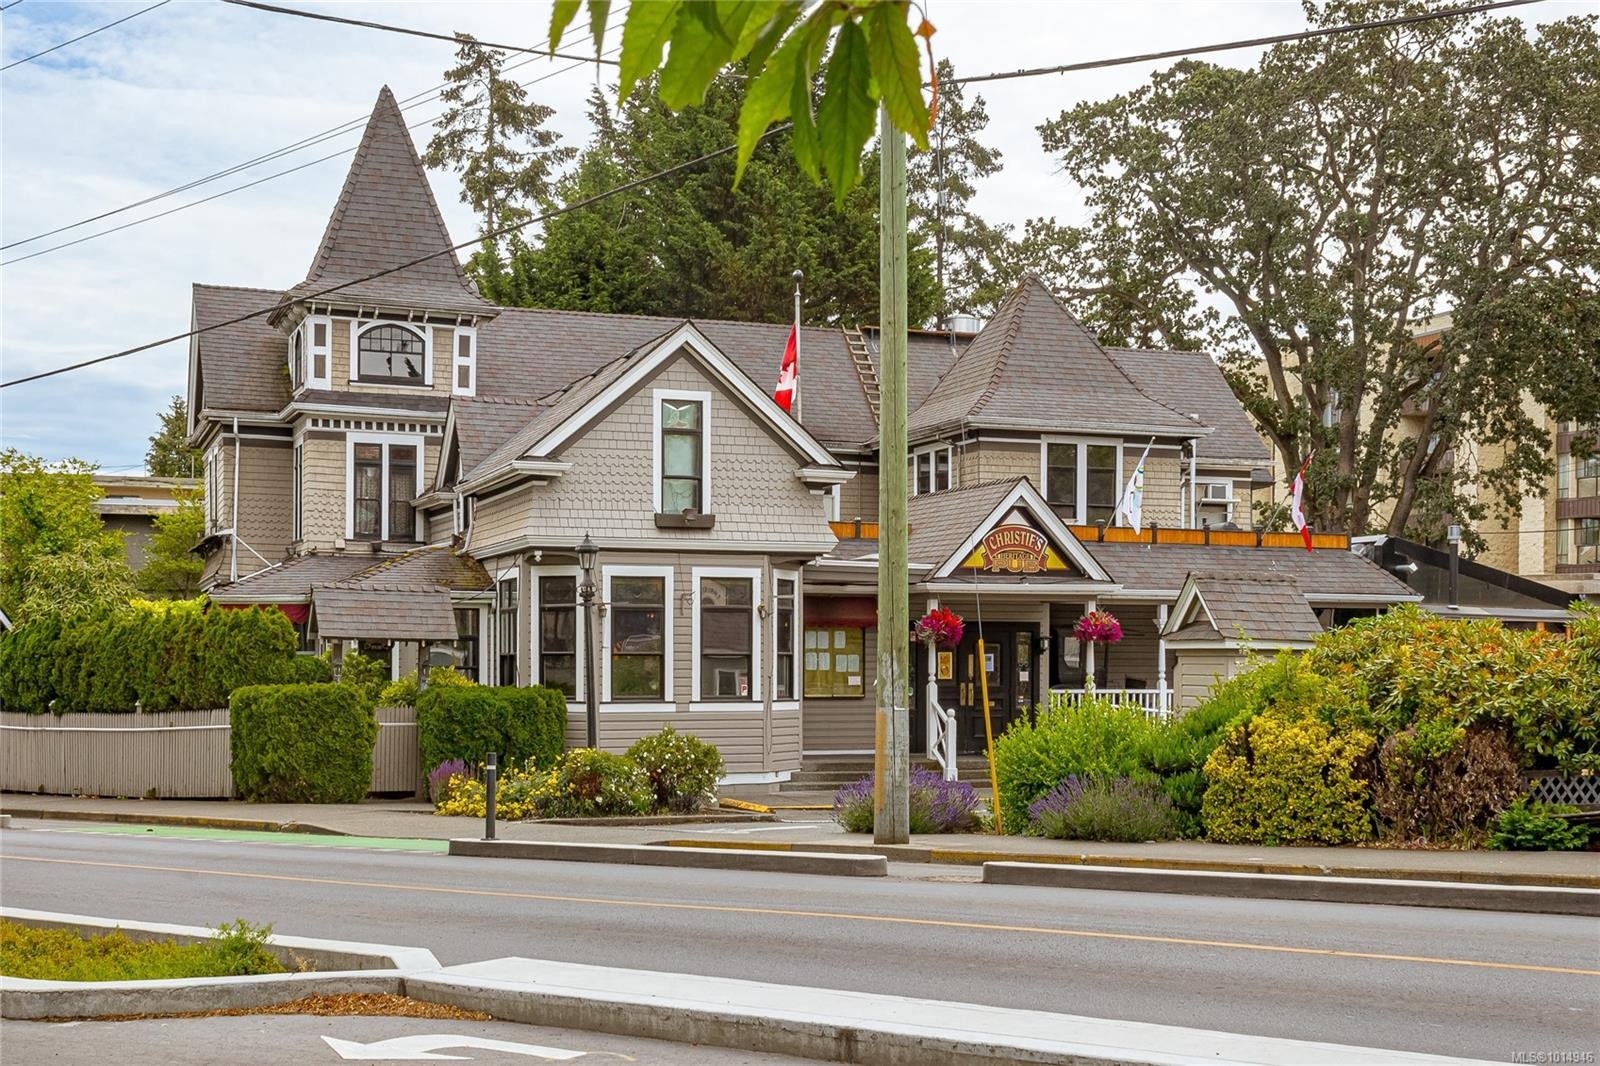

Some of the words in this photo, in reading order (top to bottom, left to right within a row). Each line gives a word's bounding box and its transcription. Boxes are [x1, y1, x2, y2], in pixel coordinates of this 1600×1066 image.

[989, 530, 1044, 552] CHRISTIE'S
[1001, 551, 1030, 560] HERITAGE
[992, 559, 1041, 573] PUB
